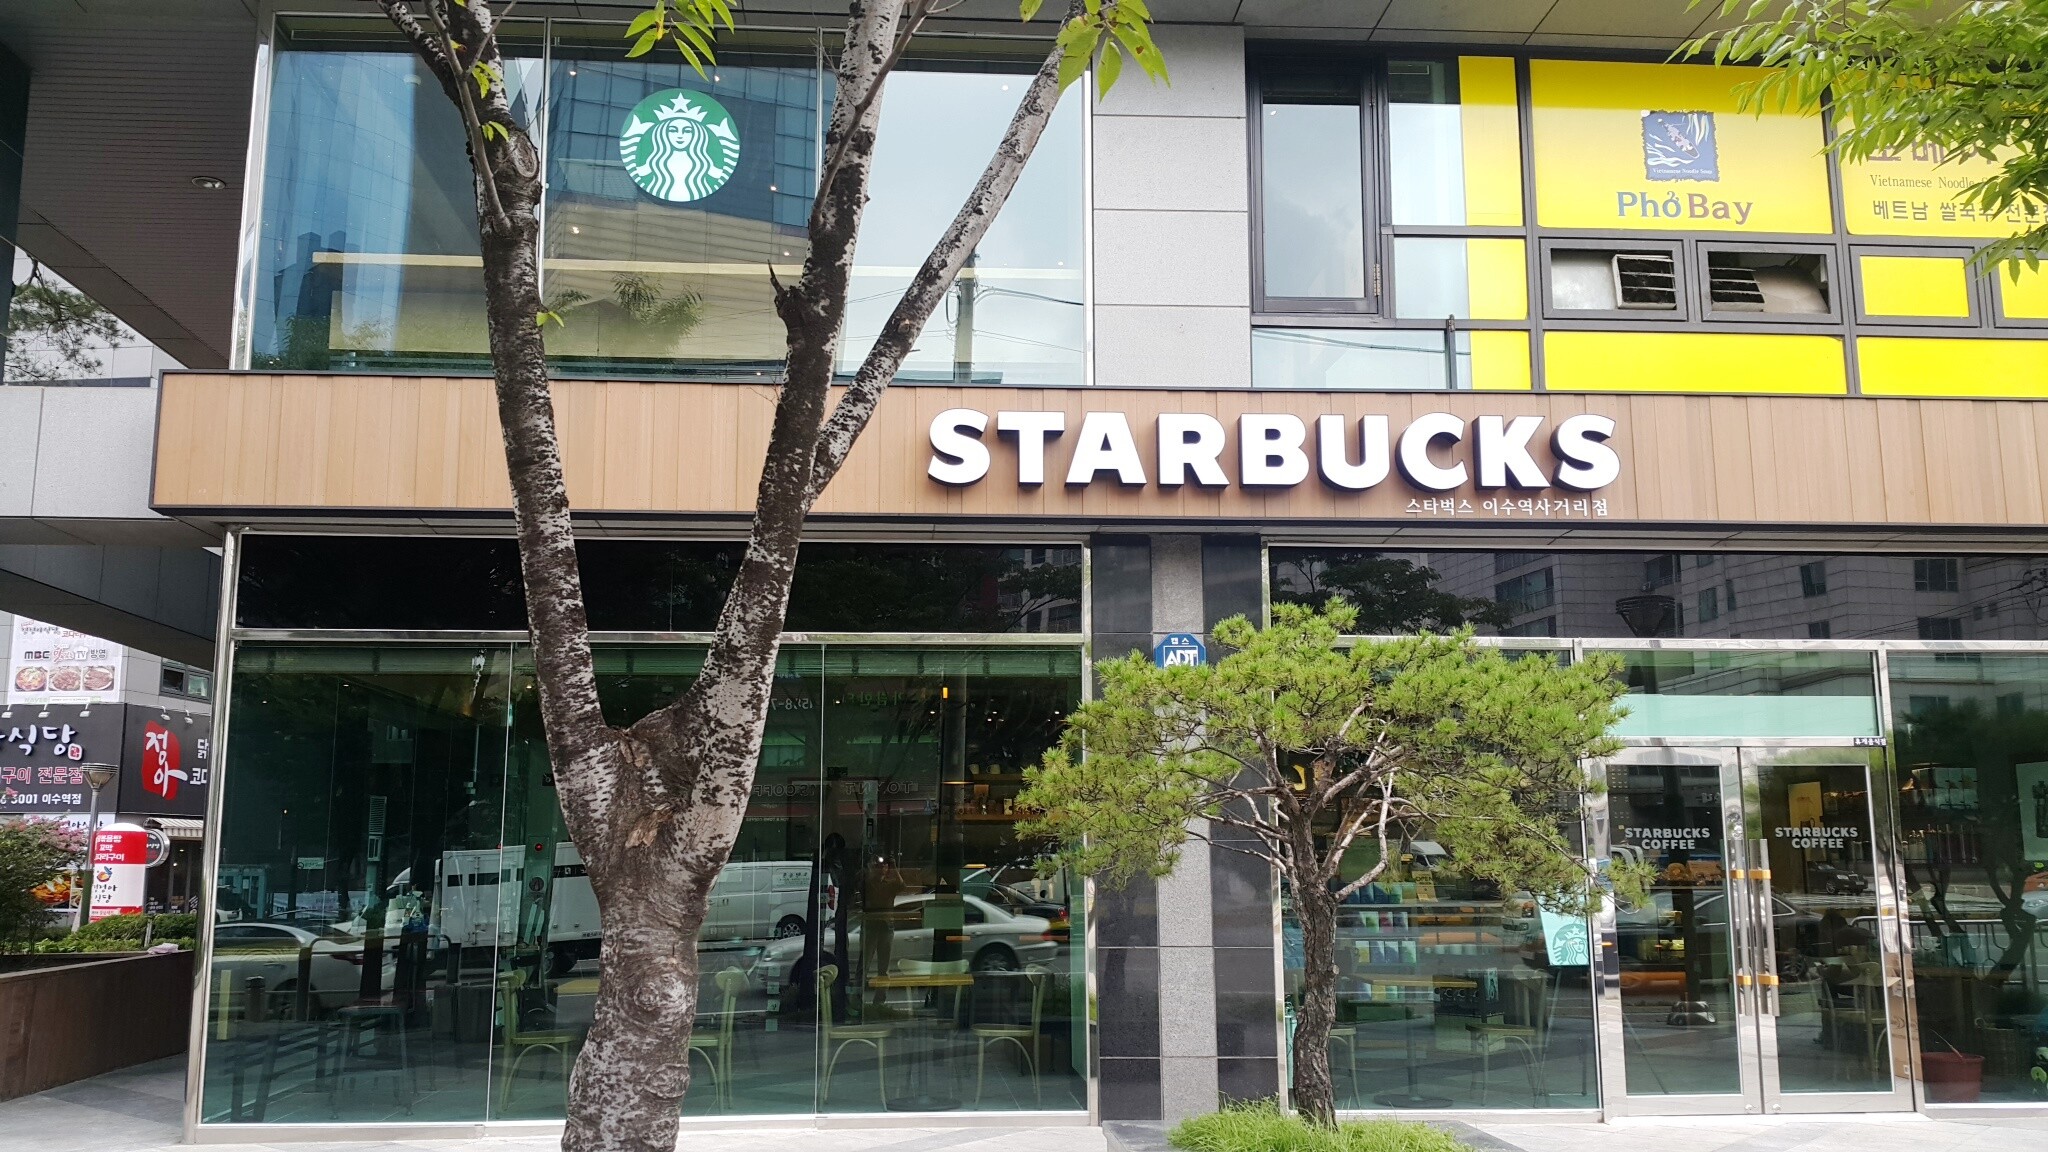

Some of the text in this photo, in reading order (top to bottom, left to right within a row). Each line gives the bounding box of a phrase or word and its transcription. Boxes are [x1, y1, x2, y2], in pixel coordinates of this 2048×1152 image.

[1870, 174, 1933, 188] Vietnamese
[1938, 176, 1974, 189] Noodle
[1616, 190, 1753, 225] Phở Bay
[1872, 200, 1929, 221] 베트남
[2005, 203, 2048, 224] 전문
[927, 408, 1622, 490] STARBUCKS
[1405, 497, 1609, 517] 스타벅스 이수역사거리점
[1170, 637, 1190, 645] 캡스
[76, 650, 87, 659] TV
[90, 649, 106, 659] 방영
[1165, 649, 1199, 667] ADT
[0, 724, 76, 756] 식당
[0, 766, 83, 785] 구이 전문점
[42, 793, 82, 805] 이수역점
[1624, 827, 1711, 839] STARBUCKS
[1774, 826, 1859, 838] STARBUCKS
[1640, 839, 1696, 850] COFFEE
[1791, 838, 1844, 849] COFFEE
